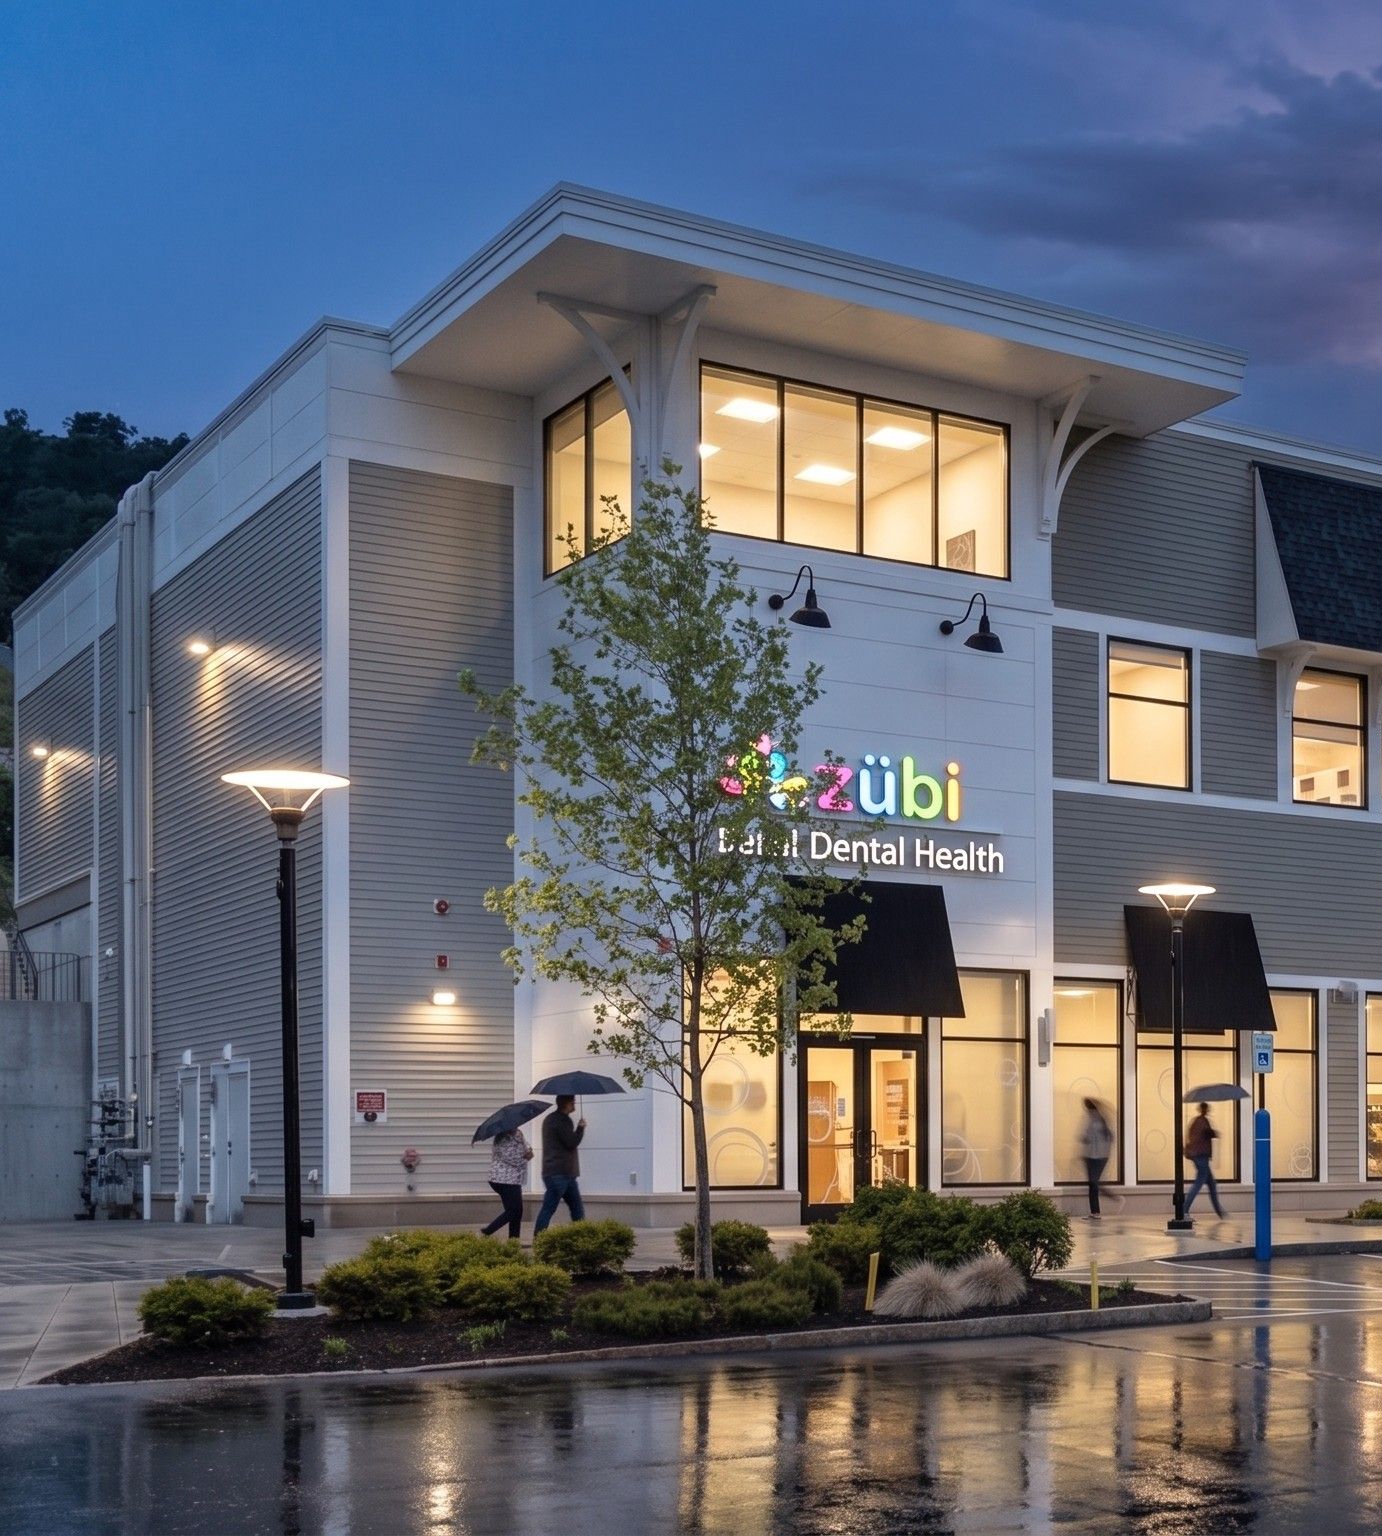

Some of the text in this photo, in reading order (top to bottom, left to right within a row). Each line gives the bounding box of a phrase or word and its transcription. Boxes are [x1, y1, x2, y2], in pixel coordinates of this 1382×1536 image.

[814, 754, 962, 822] zübi
[810, 831, 905, 866] Dental
[914, 838, 1004, 873] Health
